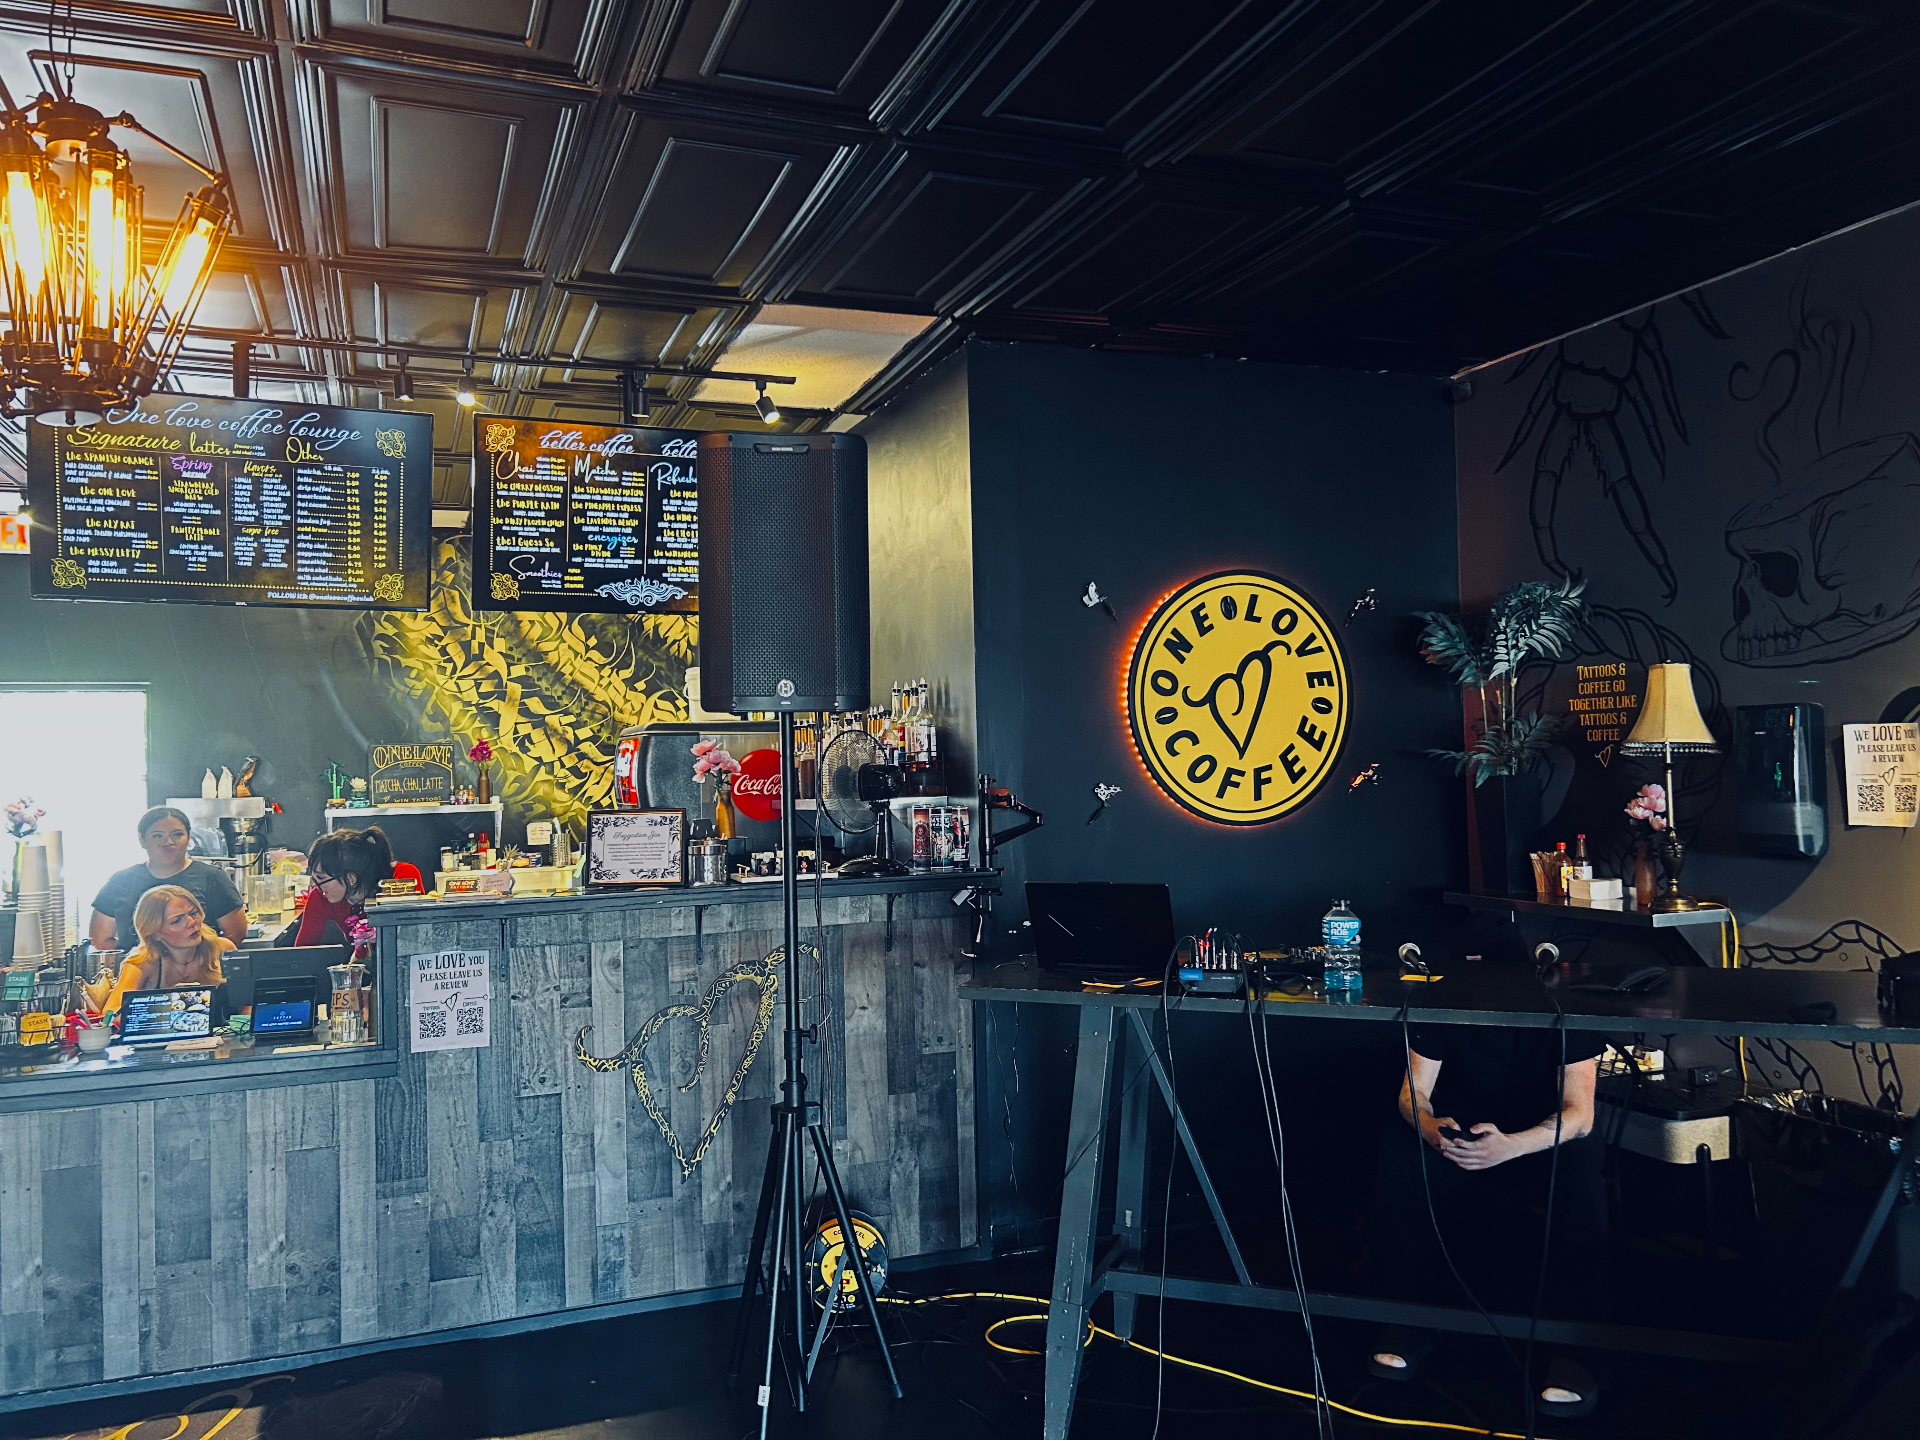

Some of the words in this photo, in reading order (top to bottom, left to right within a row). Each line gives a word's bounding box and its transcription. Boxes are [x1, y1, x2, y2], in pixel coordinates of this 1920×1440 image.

[165, 401, 214, 428] love
[218, 408, 286, 438] coffee
[288, 412, 363, 451] lounge
[66, 425, 182, 451] Signature
[189, 431, 231, 455] lattes
[539, 429, 587, 451] better
[589, 433, 635, 458] coffee
[660, 438, 698, 459] bette
[286, 436, 325, 463] Other
[66, 451, 81, 461] the
[84, 453, 121, 464] SPANISH
[123, 457, 155, 466] ORANGE
[170, 455, 214, 475] Spring
[495, 449, 536, 480] Chai
[574, 452, 617, 483] Matcha
[80, 486, 96, 496] the
[98, 488, 114, 497] ONE
[116, 488, 137, 498] LOVE
[496, 481, 509, 490] the
[509, 482, 534, 491] CHERRY
[534, 484, 564, 493] BLOSSOM
[573, 486, 585, 494] the
[669, 489, 682, 498] the
[496, 498, 511, 508] the
[512, 499, 540, 510] PURPLE
[540, 501, 560, 510] RAIN
[571, 501, 584, 510] the
[584, 502, 616, 511] PINEAPPLE
[616, 503, 642, 513] EXPRESS
[86, 518, 102, 528] the
[491, 517, 504, 525] the
[573, 515, 585, 525] the
[663, 512, 676, 522] the
[0, 517, 28, 550] EX
[242, 526, 263, 537] sugar
[264, 525, 280, 537] free
[495, 535, 511, 546] the
[517, 537, 543, 548] Guess
[544, 537, 555, 548] So
[572, 543, 584, 551] the
[587, 533, 639, 551] energizer
[69, 546, 84, 556] the
[87, 547, 115, 558] MESSY
[116, 548, 141, 559] LEFTY
[508, 554, 563, 580] Smoothies
[1150, 602, 1215, 697] ONE
[1243, 593, 1335, 690] LOVE
[1618, 663, 1626, 676] &
[1578, 680, 1611, 695] COFFEE
[1612, 679, 1626, 693] GO
[1568, 696, 1615, 712] TOGETHER
[1616, 694, 1638, 709] LIKE
[1579, 712, 1618, 727] TATTOOS
[1619, 711, 1628, 725] &
[1586, 728, 1620, 742] COFFEE
[1872, 725, 1902, 742] LOVE
[1903, 728, 1918, 740] YOU
[1857, 744, 1885, 754] PLEASE
[1886, 743, 1906, 753] LEAVE
[1907, 743, 1917, 753] US
[373, 745, 412, 769] ONE
[412, 745, 454, 768] LOVE
[1165, 714, 1328, 802] COFFEE
[1878, 754, 1905, 763] REVIEW
[421, 776, 444, 790] LATTE
[733, 773, 782, 796] Coca-Co
[613, 831, 648, 842] Suggestion
[648, 830, 661, 840] Jar
[1330, 921, 1359, 929] POWER
[1330, 928, 1350, 936] ADE
[434, 952, 466, 970] LOVE
[468, 955, 485, 966] YOU
[420, 971, 448, 983] PLEASE
[449, 970, 472, 980] LEAVE
[473, 968, 483, 977] US
[433, 982, 439, 991] A
[440, 979, 469, 990] REVIEW
[331, 992, 350, 1007] IPS
[28, 1017, 49, 1027] STASH
